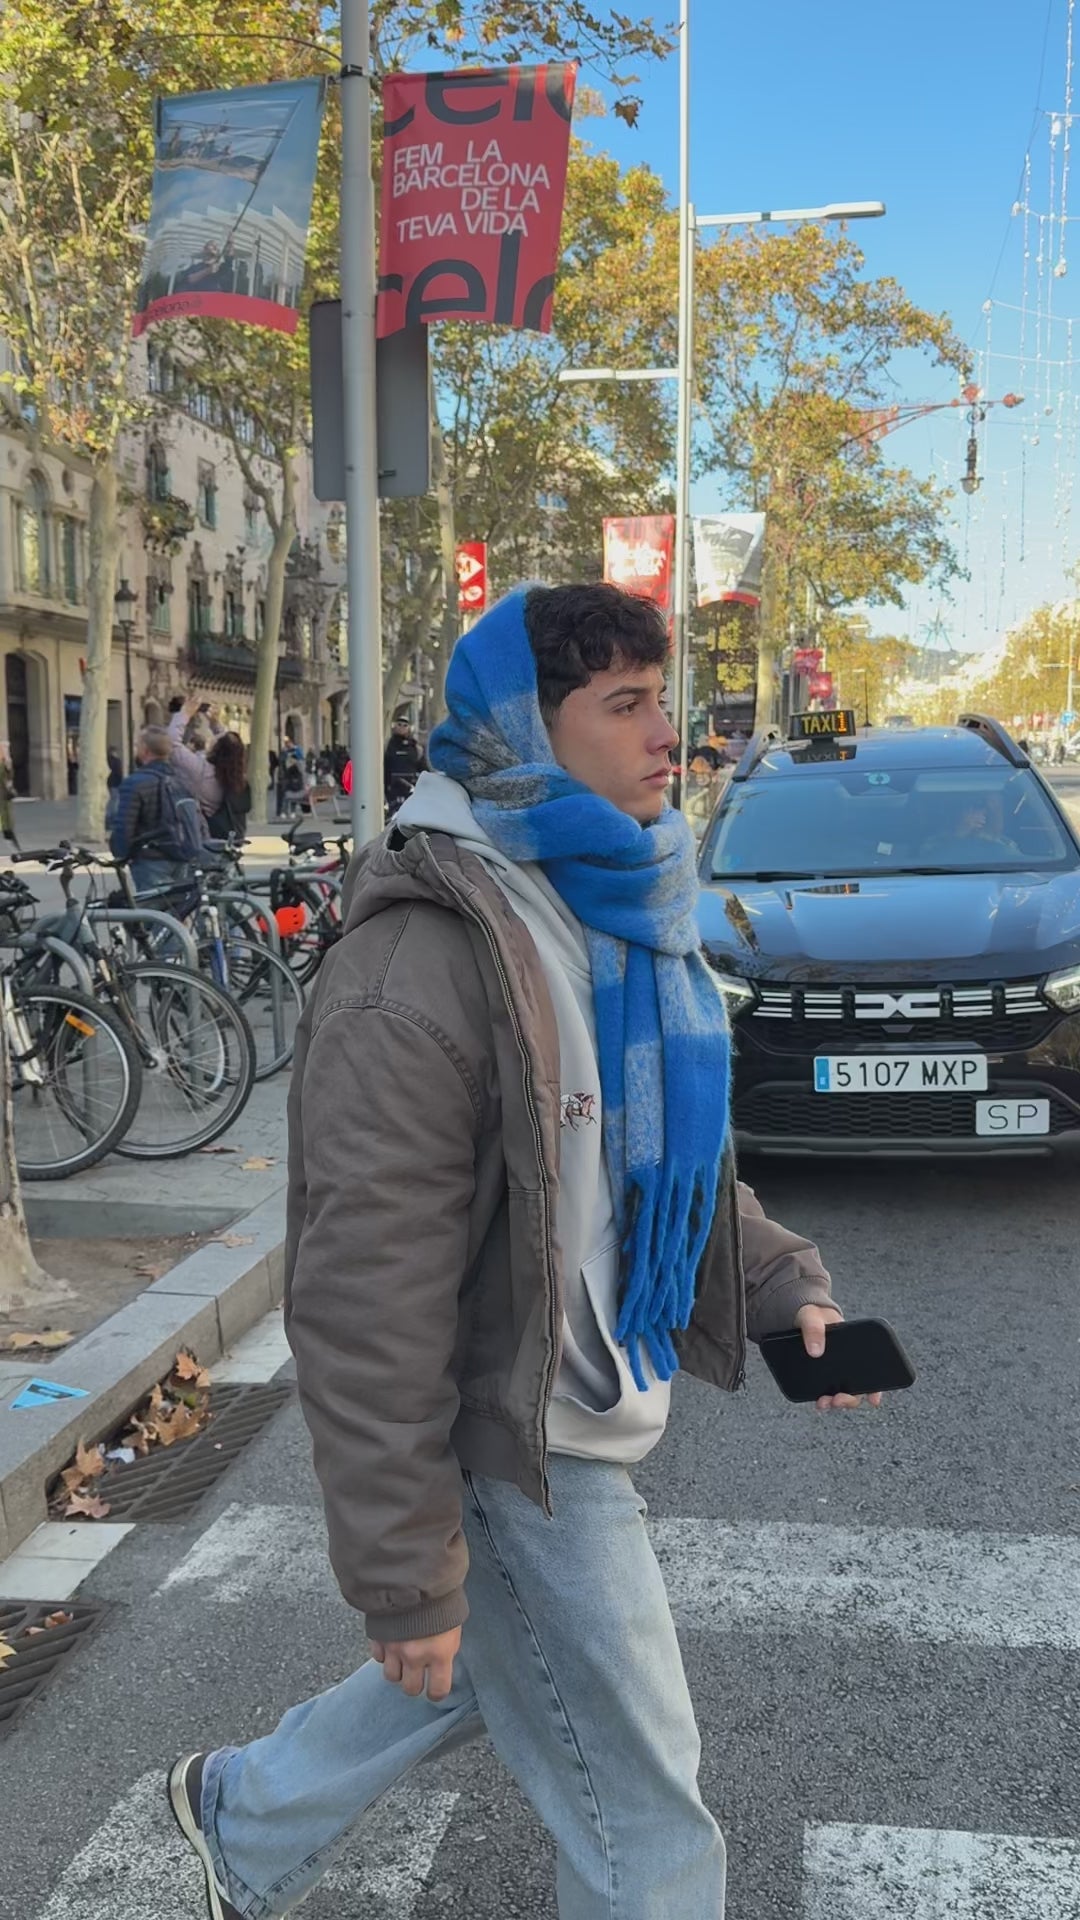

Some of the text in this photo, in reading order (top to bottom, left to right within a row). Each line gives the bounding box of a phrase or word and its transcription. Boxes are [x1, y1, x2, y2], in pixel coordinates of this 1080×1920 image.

[393, 139, 502, 173] FEM LA
[393, 163, 550, 198] BARCELONA
[461, 187, 540, 213] DE LA
[396, 211, 528, 243] TEVA VIDA
[836, 1060, 977, 1087] 5107 MXP
[988, 1104, 1038, 1130] SP
